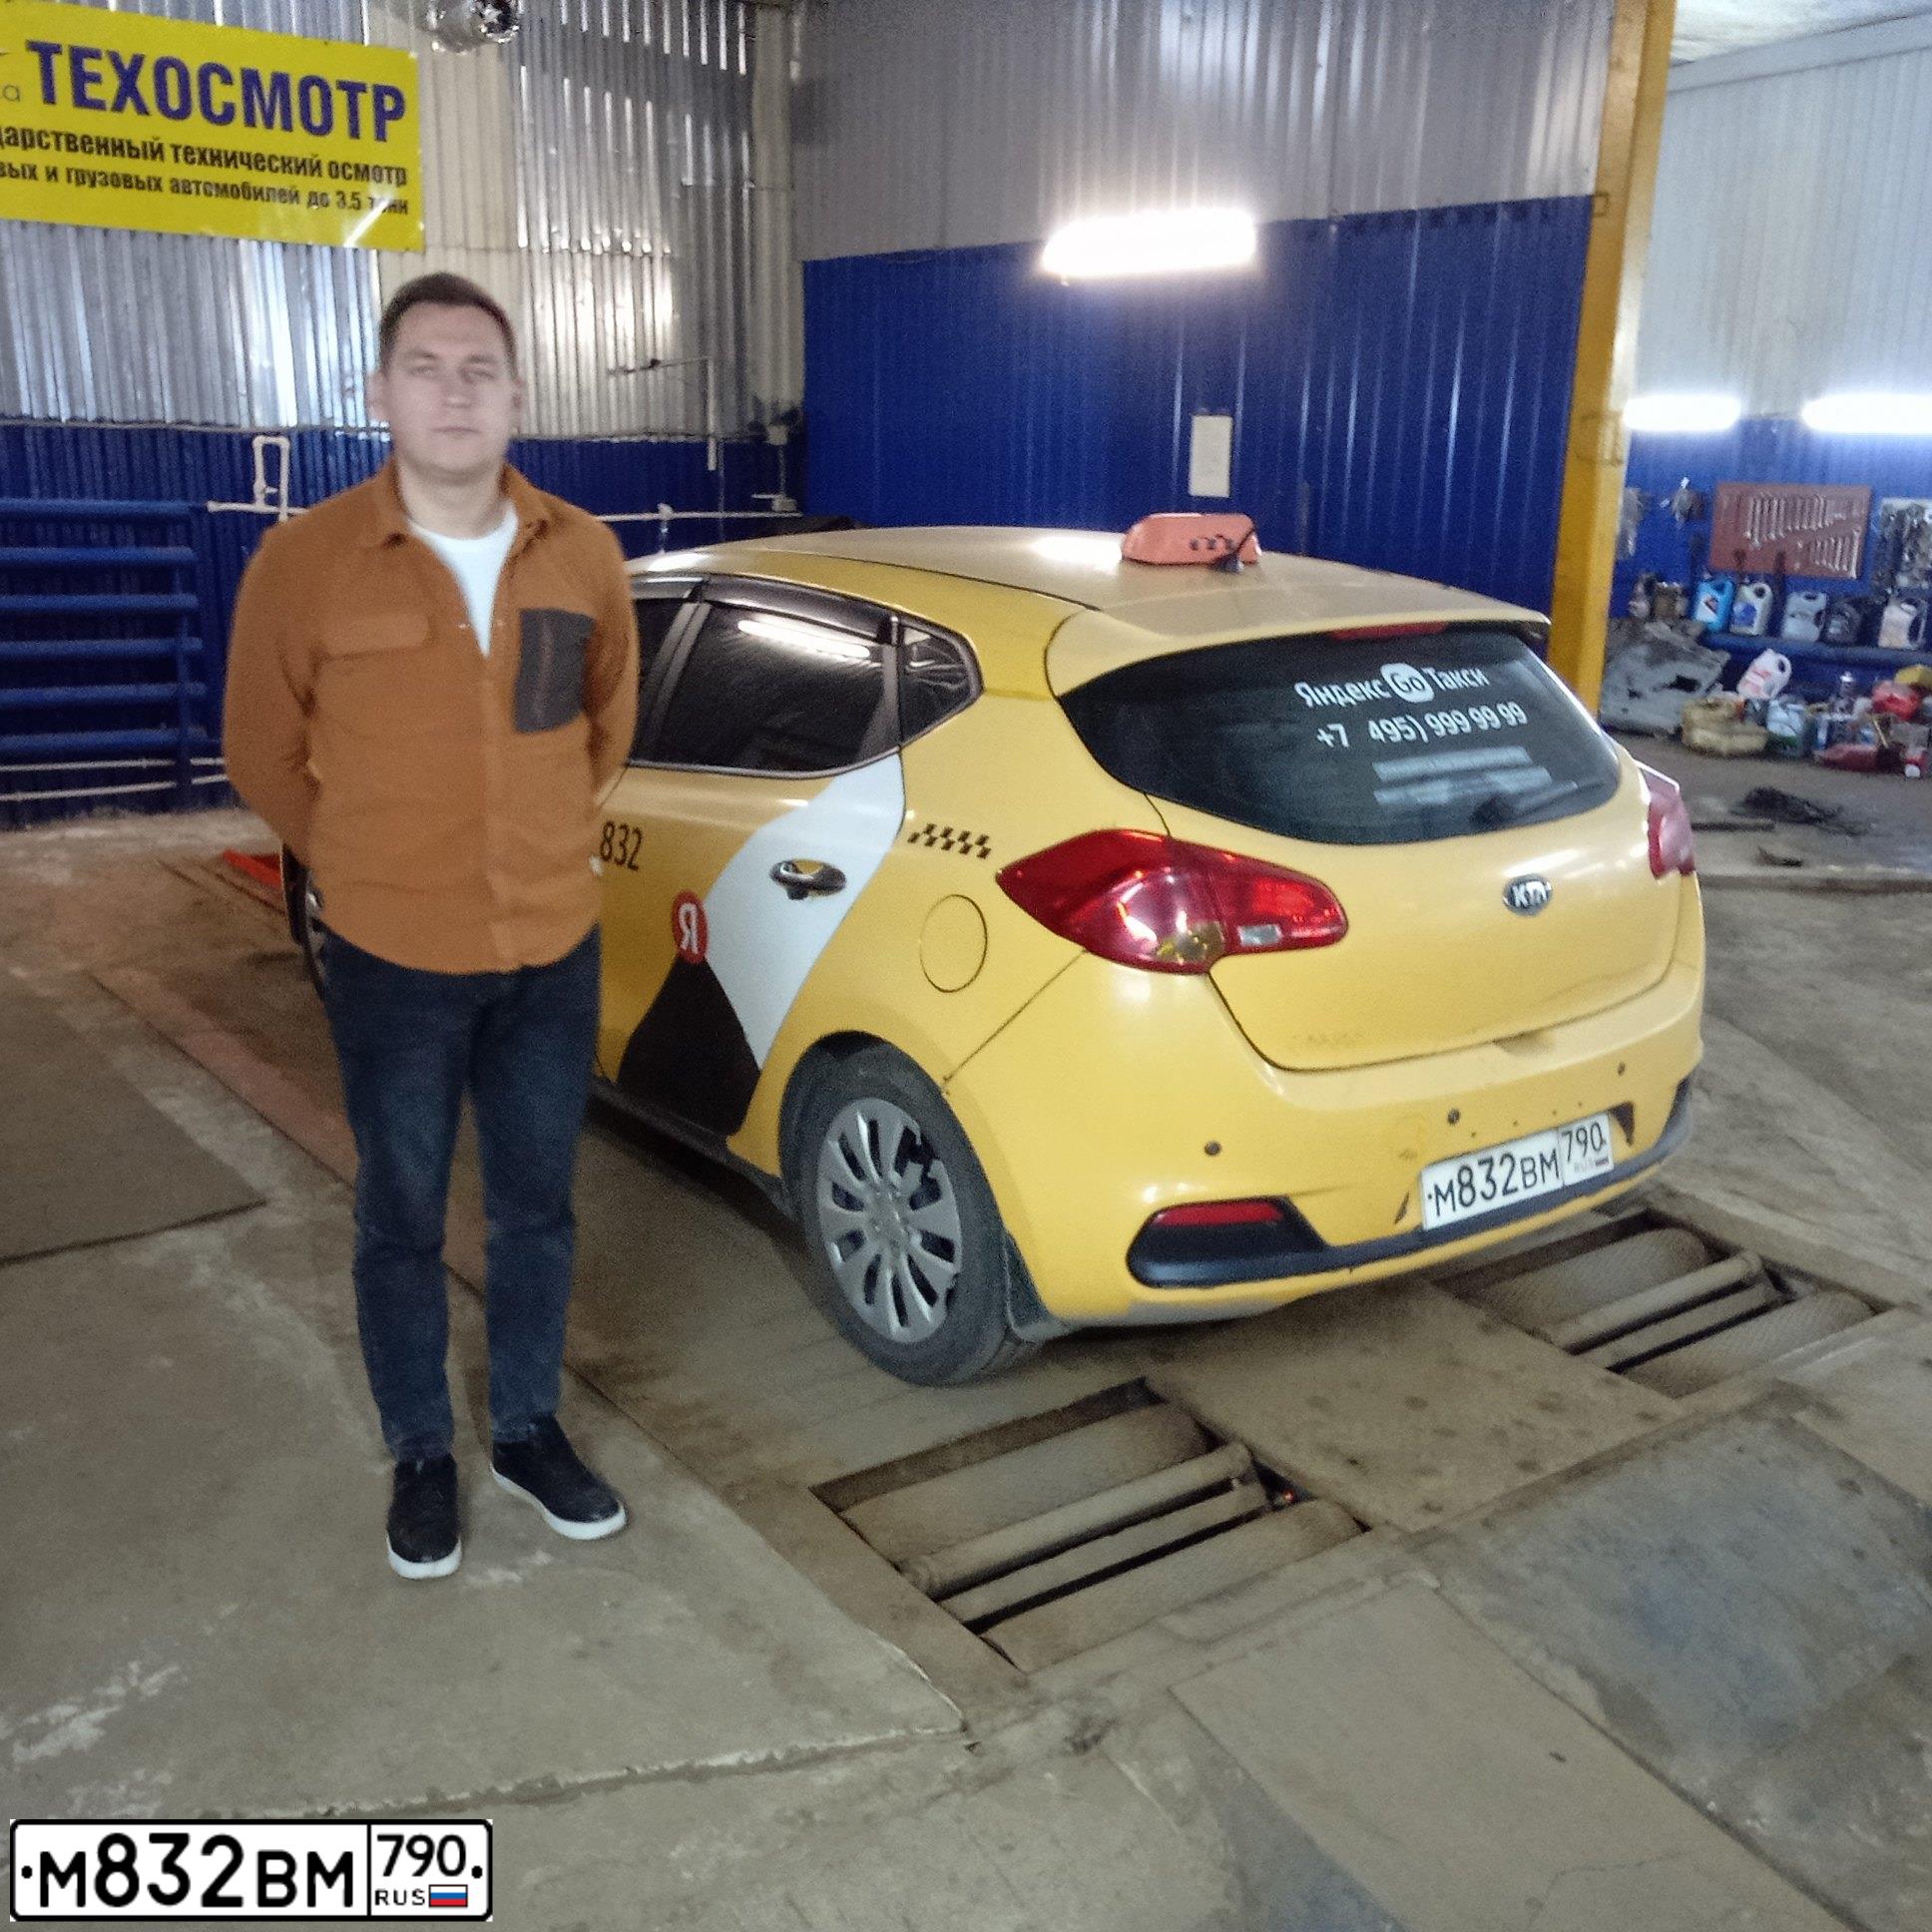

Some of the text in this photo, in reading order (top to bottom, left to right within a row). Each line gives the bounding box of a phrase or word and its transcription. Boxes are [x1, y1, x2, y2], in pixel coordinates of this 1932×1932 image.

[26, 40, 406, 143] ТЕХОСМОТР
[45, 165, 59, 183] и
[66, 167, 163, 190] грузовых
[170, 176, 299, 206] автомобилей
[306, 190, 330, 210] до
[170, 143, 322, 178] технический
[327, 160, 408, 188] осмотр
[1293, 678, 1393, 708] Яндекс
[1421, 667, 1491, 692] Такси
[1315, 701, 1528, 748] +7 495) 999 99 99
[599, 820, 644, 872] 832
[678, 902, 700, 955] Я
[1561, 1121, 1604, 1163] 790
